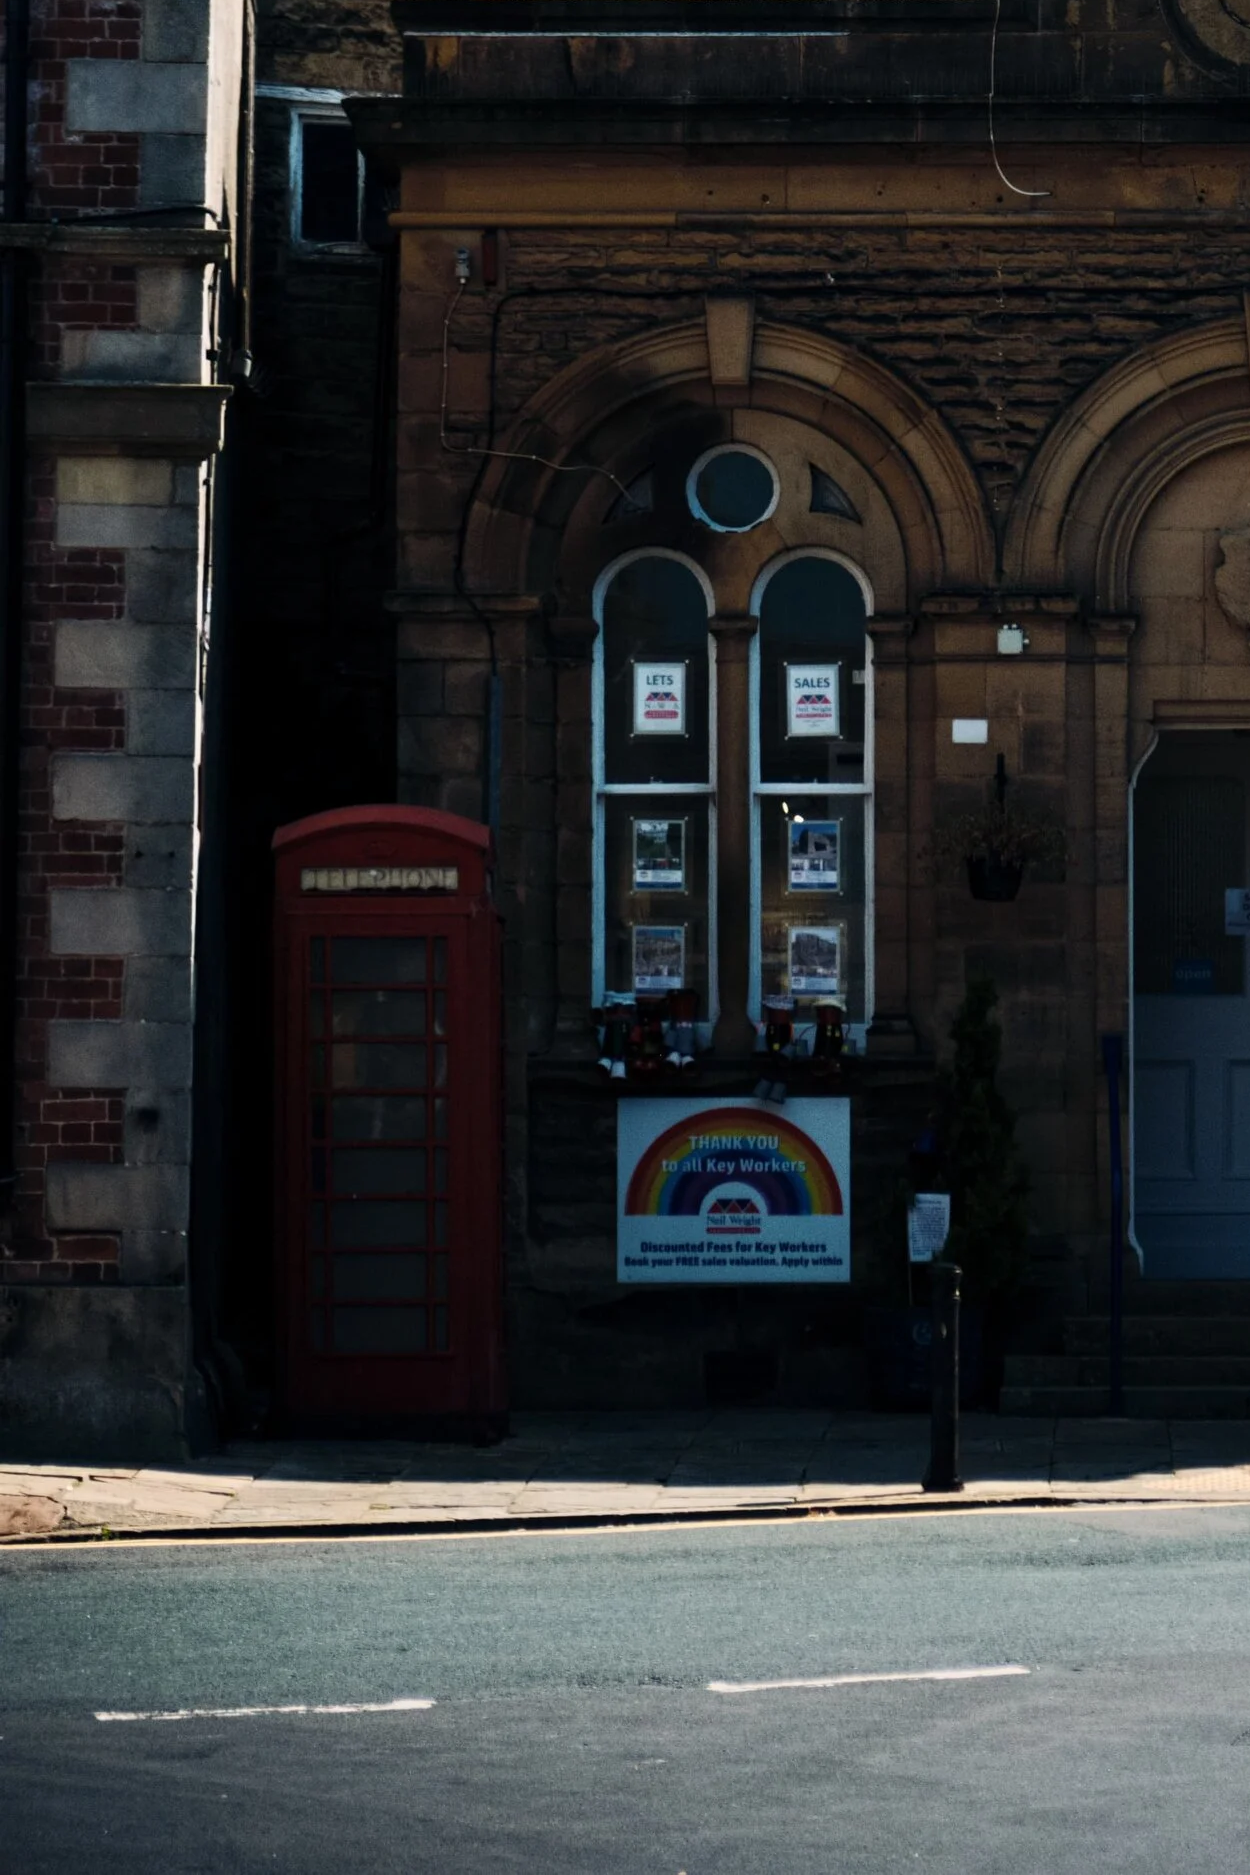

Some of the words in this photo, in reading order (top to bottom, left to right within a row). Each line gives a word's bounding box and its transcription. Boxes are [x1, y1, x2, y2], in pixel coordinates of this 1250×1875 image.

[646, 674, 674, 686] LETS
[794, 677, 830, 689] SALES
[688, 1135, 743, 1151] THANK
[748, 1135, 780, 1150] YOU
[661, 1159, 678, 1173] to
[682, 1158, 702, 1172] all
[706, 1159, 735, 1175] Key
[739, 1158, 807, 1173] Workers
[707, 1215, 726, 1225] Neil
[730, 1215, 761, 1226] Wright
[641, 1242, 704, 1252] Discounted
[707, 1242, 732, 1252] Fees
[735, 1242, 752, 1252] for
[755, 1242, 776, 1254] Key
[779, 1242, 826, 1252] Workers
[624, 1257, 649, 1266] Book
[651, 1259, 674, 1268] your
[675, 1257, 699, 1266] FREE
[702, 1257, 727, 1266] sales
[781, 1257, 809, 1268] Apply
[812, 1256, 843, 1266] within
